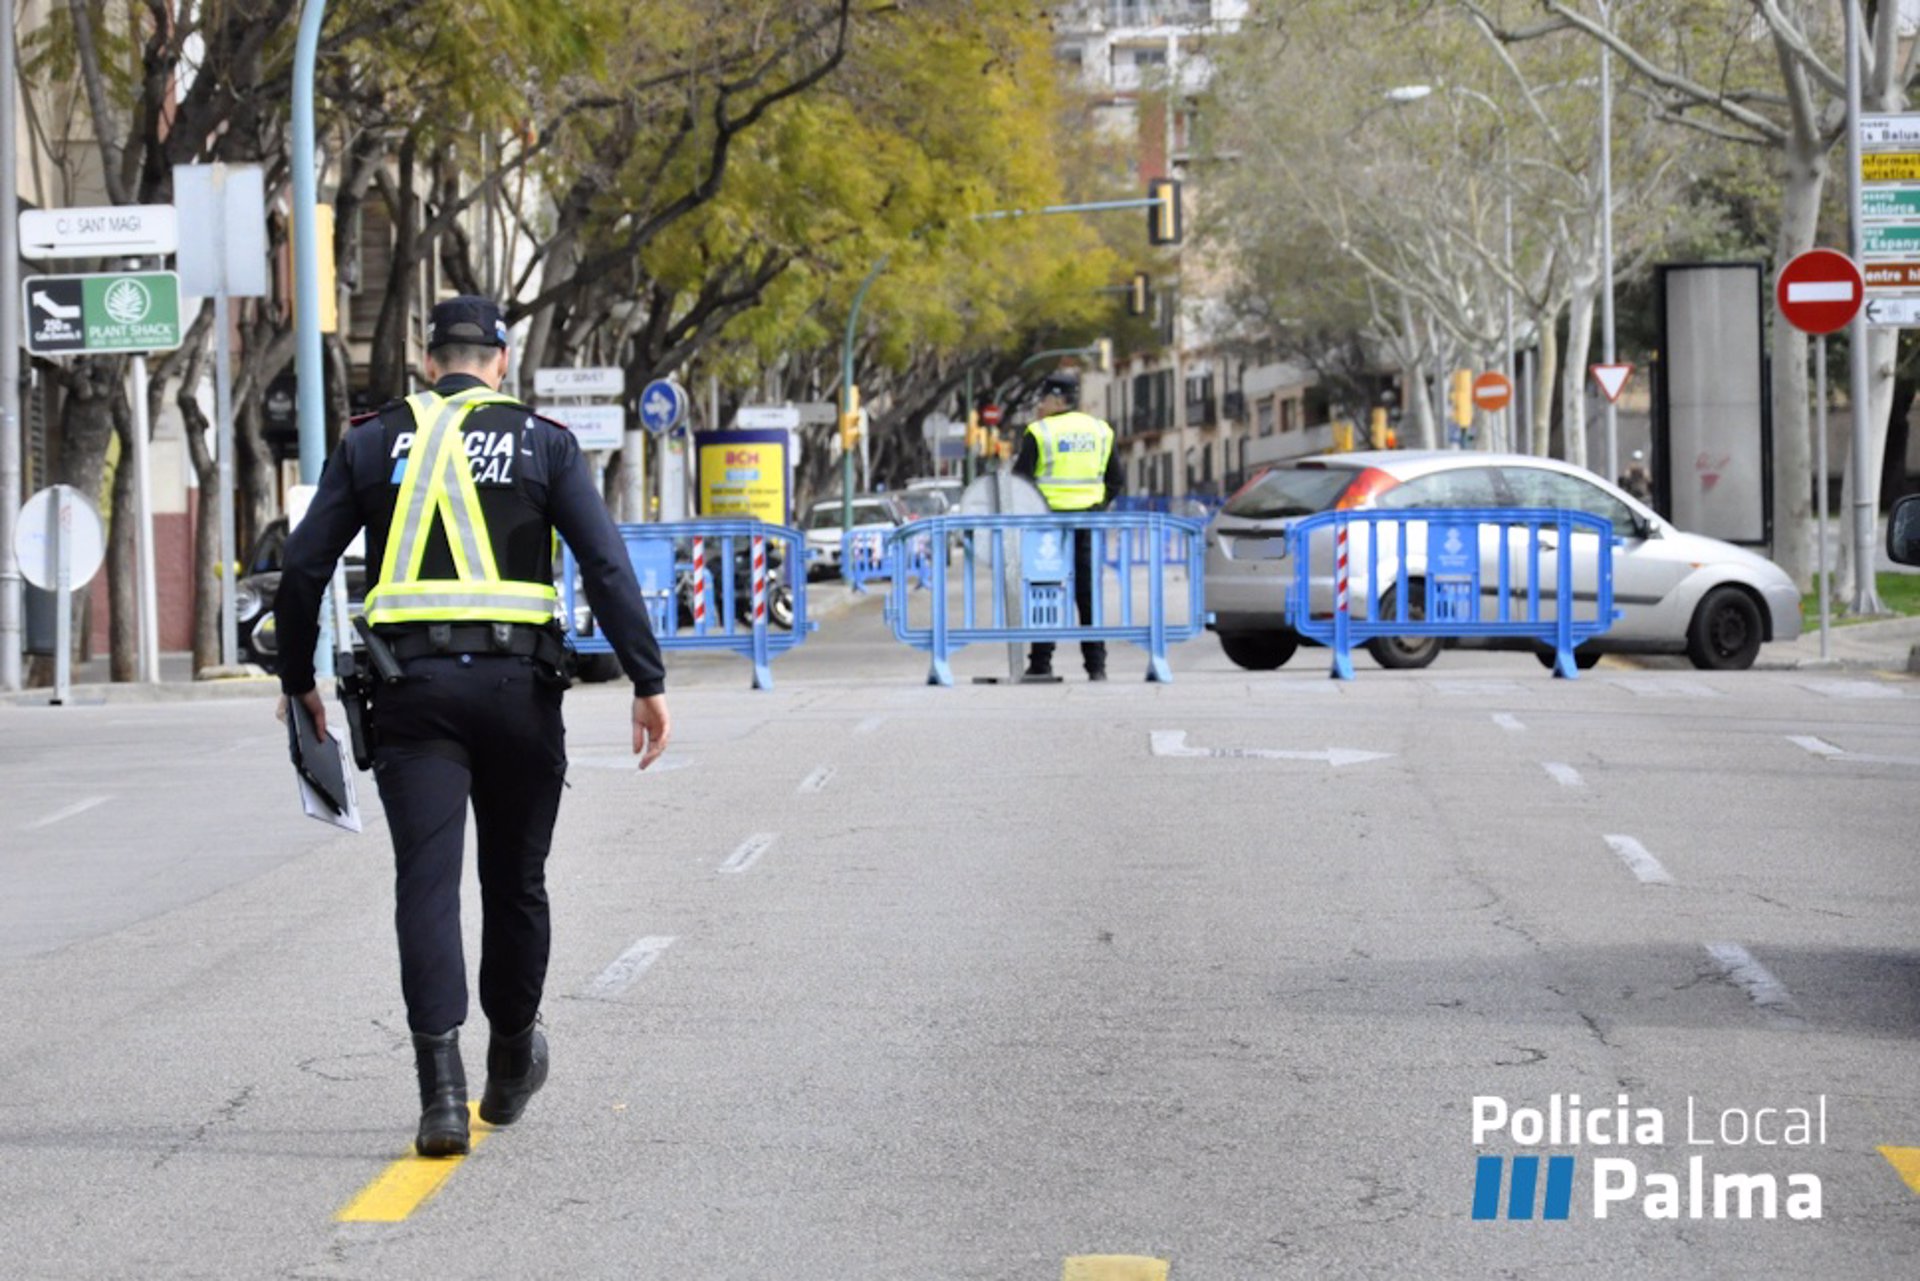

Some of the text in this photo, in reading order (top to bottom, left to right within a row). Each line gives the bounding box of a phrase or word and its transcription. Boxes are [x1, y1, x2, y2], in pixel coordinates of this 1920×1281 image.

[78, 217, 106, 233] SANT
[88, 325, 127, 338] PLANT
[131, 322, 172, 336] SHACK
[390, 431, 515, 459] PCIA
